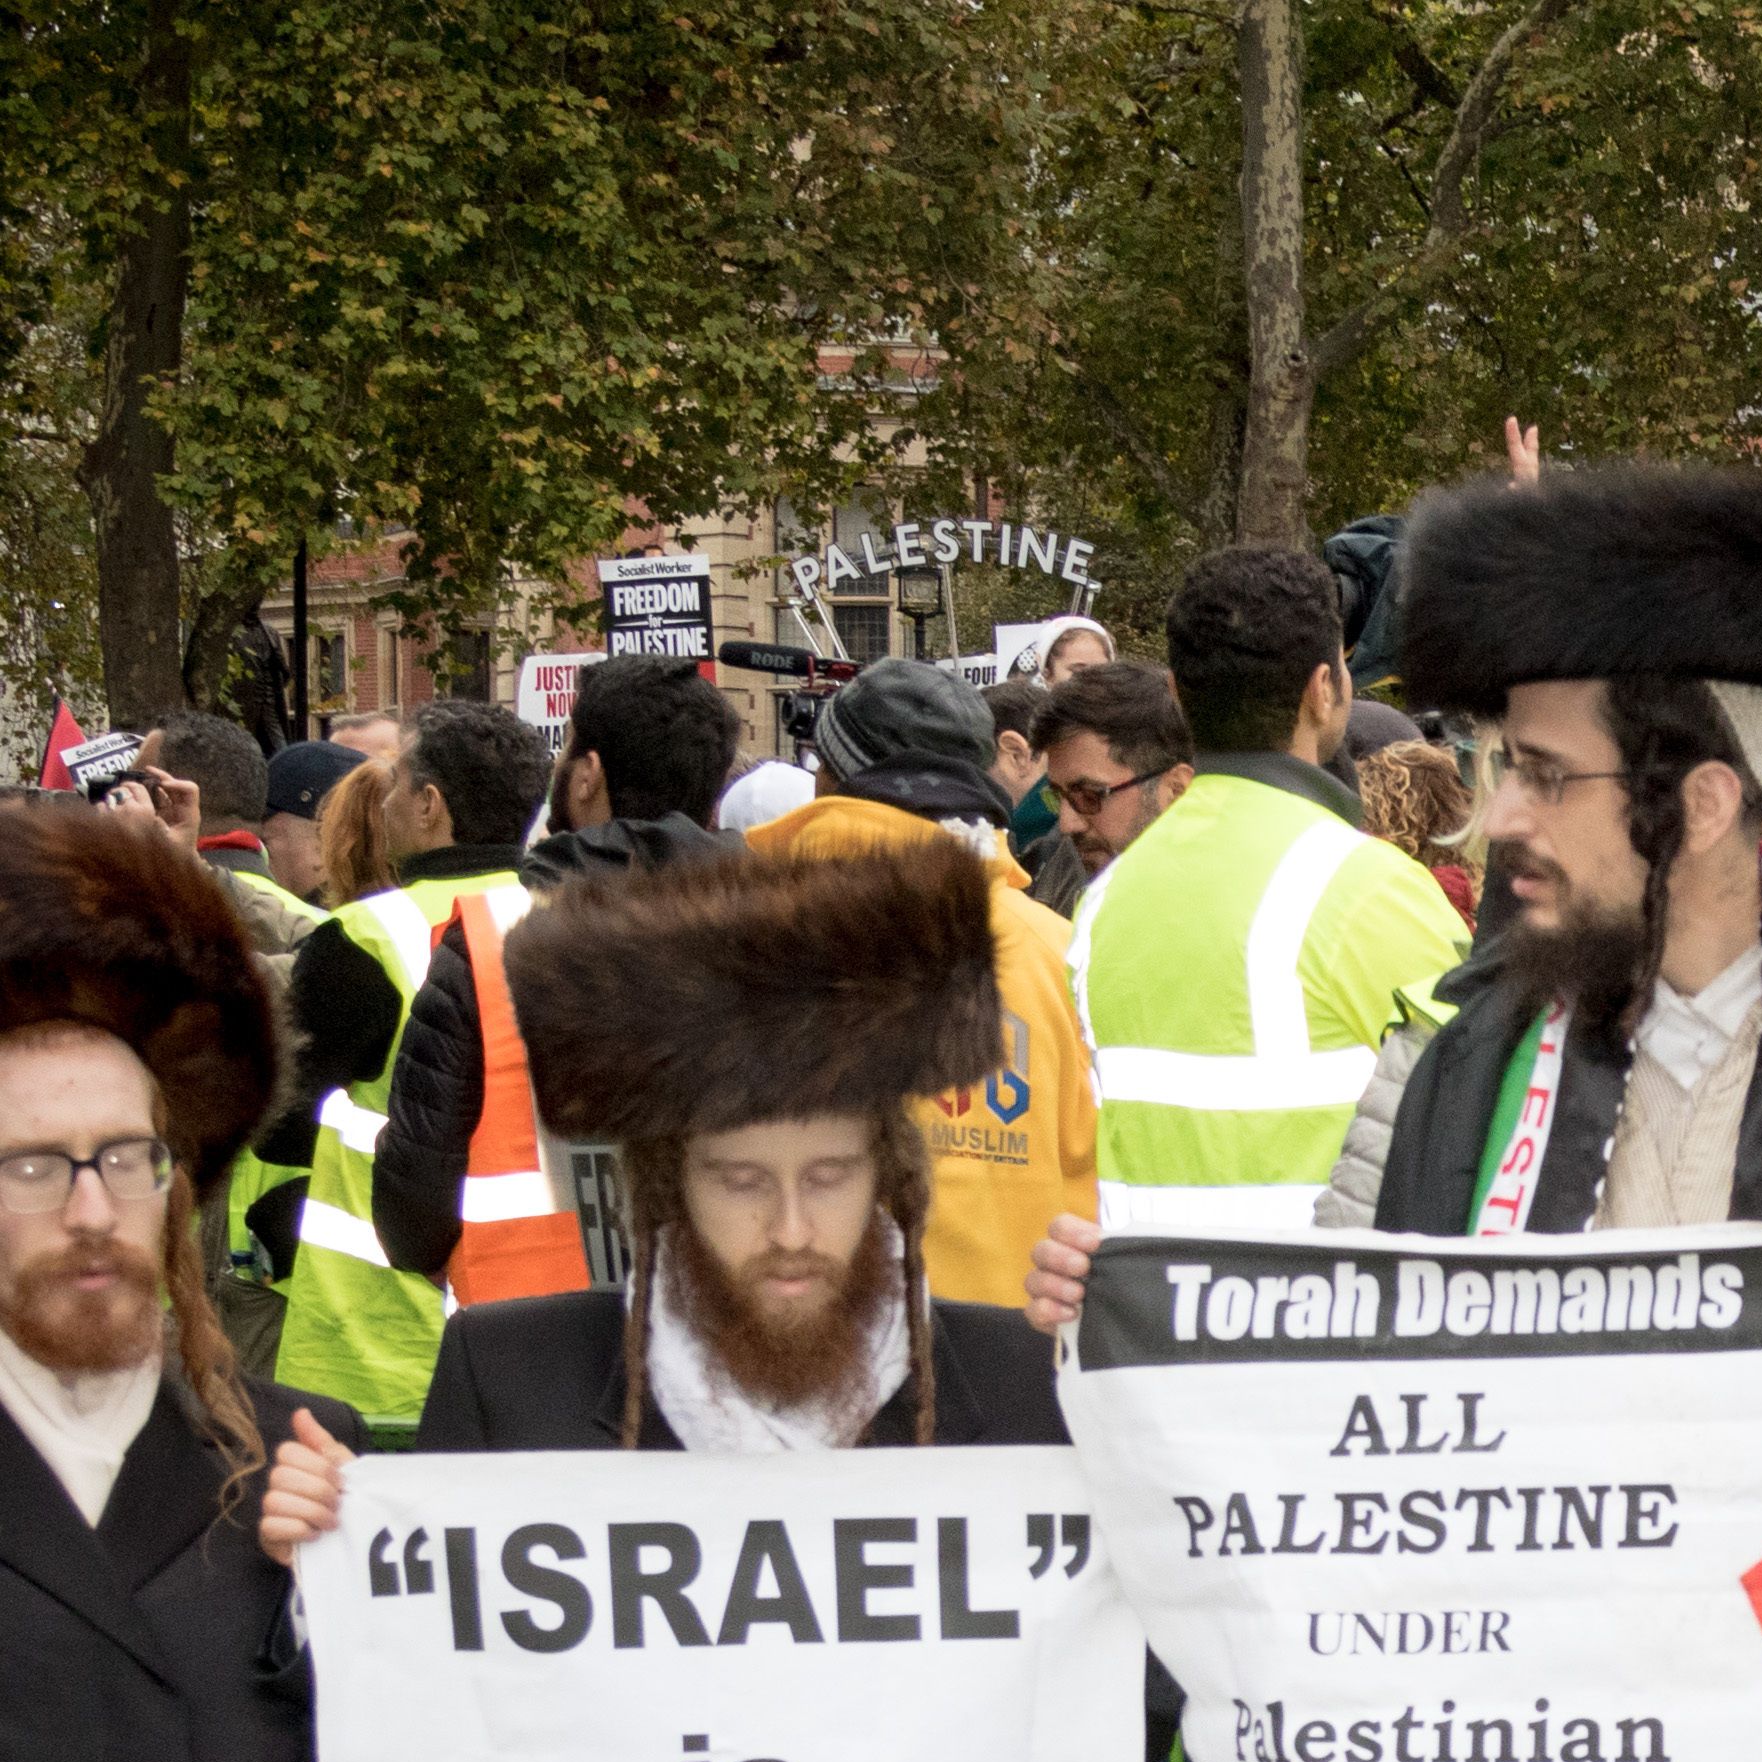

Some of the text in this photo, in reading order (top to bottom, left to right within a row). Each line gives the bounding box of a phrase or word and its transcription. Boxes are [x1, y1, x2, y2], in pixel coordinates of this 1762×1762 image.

[617, 562, 692, 578] Socialist Worker
[792, 519, 1095, 601] PALESTINE
[613, 582, 700, 616] FREEDOM
[612, 627, 709, 656] PALESTINE
[930, 1122, 1029, 1155] MUSLIM
[1168, 1253, 1743, 1342] Torah Demands
[1330, 1391, 1507, 1456] ALL
[1173, 1484, 1680, 1559] PALESTINE
[368, 1513, 1092, 1654] “ISRAEL”
[1308, 1611, 1512, 1656] UNDER
